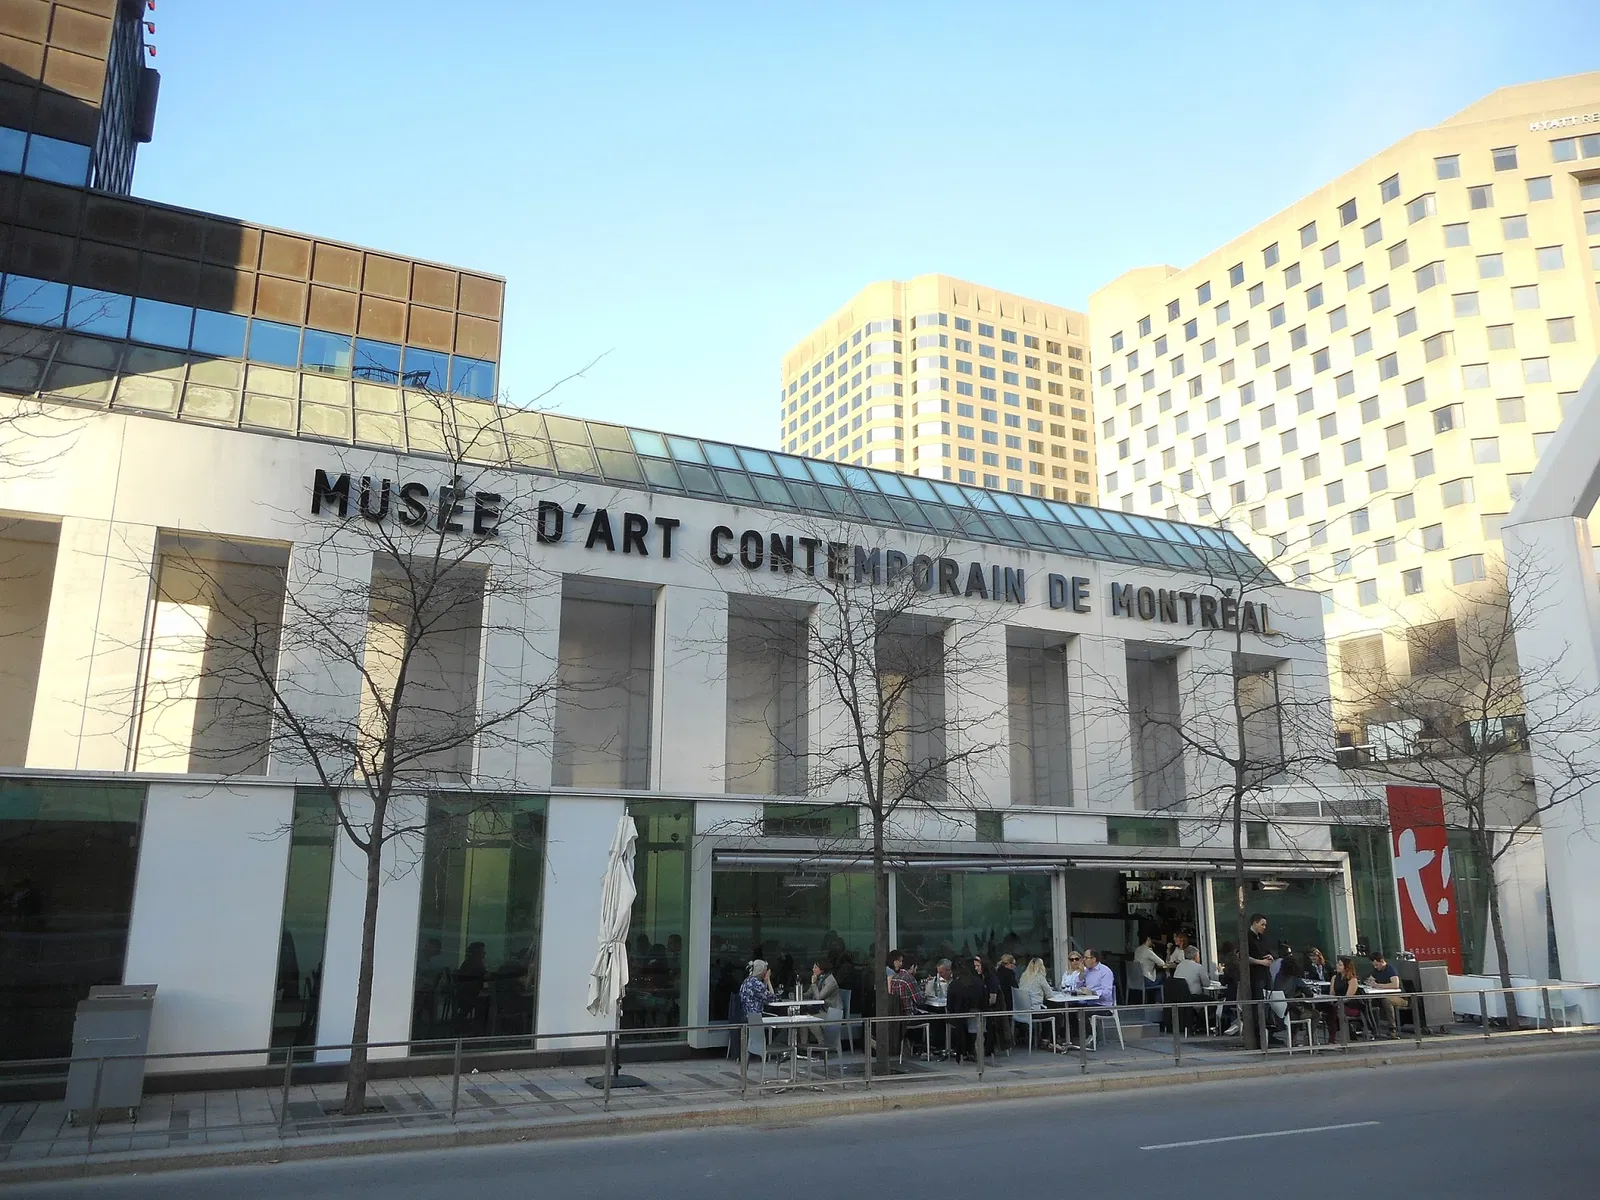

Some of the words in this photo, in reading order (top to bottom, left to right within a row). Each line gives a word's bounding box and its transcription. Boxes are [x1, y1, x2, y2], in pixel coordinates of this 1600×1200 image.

[1529, 116, 1577, 132] HYATT
[311, 468, 500, 536] MUSÉE
[536, 499, 680, 558] D'ART
[709, 525, 1026, 604] CONTEMPORAIN
[1048, 573, 1091, 613] DE
[1111, 582, 1279, 636] MONTRÉAL
[1409, 947, 1457, 955] BRASSERIE
